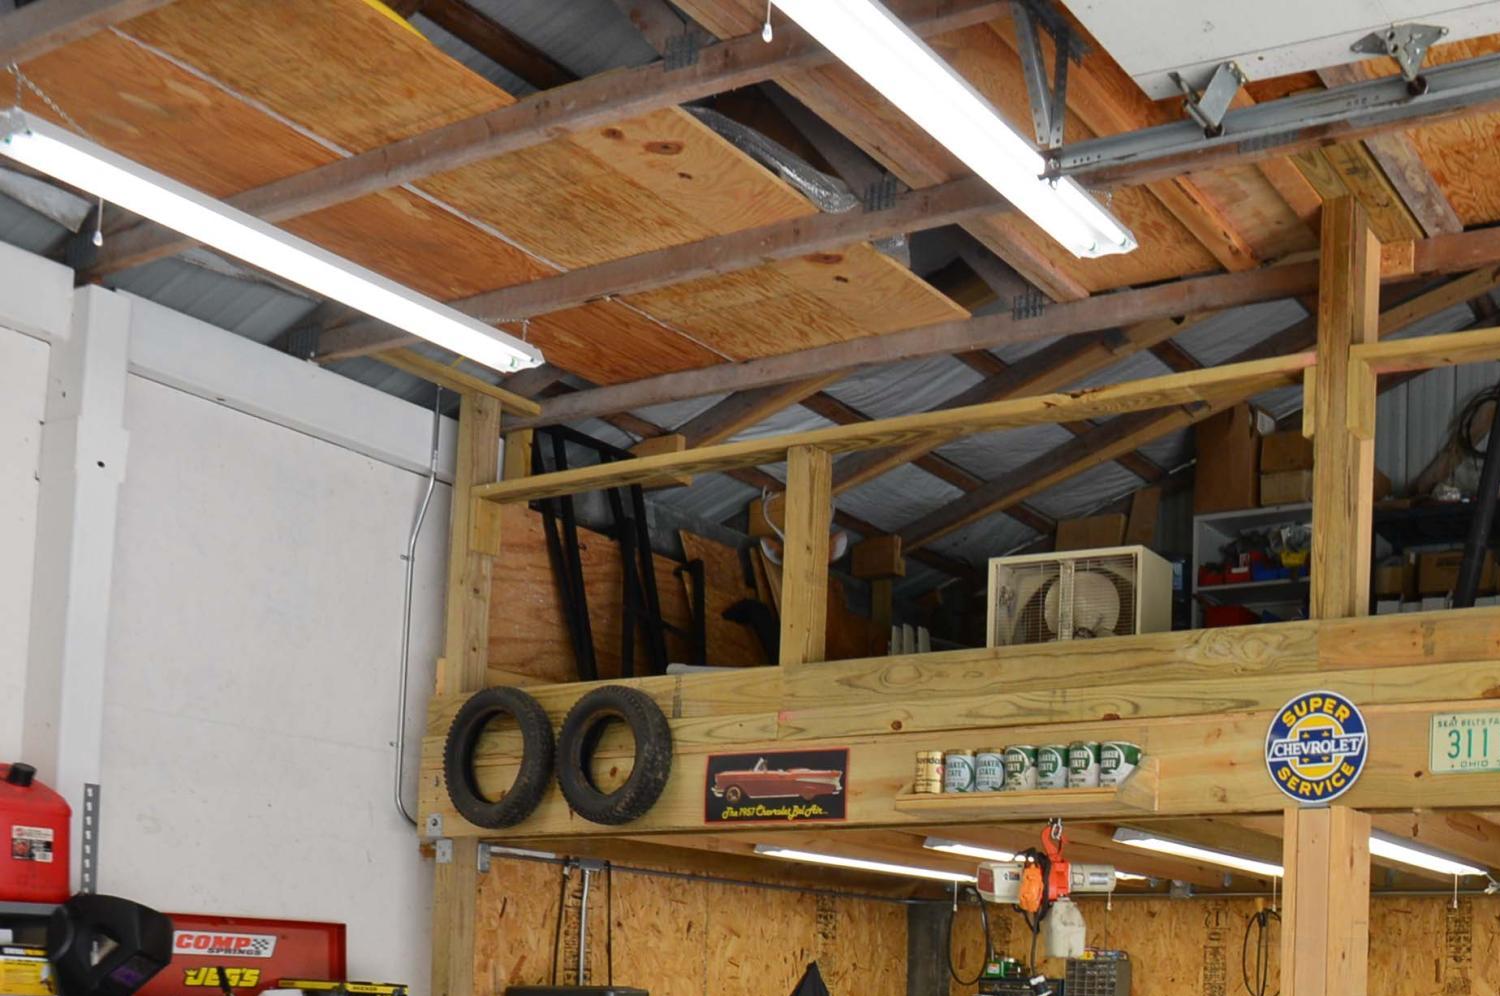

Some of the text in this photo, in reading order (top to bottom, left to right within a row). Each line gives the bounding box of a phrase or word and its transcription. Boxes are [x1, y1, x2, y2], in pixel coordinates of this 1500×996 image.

[1282, 697, 1351, 727] SUPER
[1461, 718, 1486, 727] BELTS
[1274, 738, 1361, 757] CHEVROLET
[1447, 727, 1488, 760] 311
[1460, 760, 1489, 769] OHIO
[1277, 762, 1355, 796] SERVICE
[175, 933, 253, 950] COMP
[207, 947, 262, 956] SPRINGS
